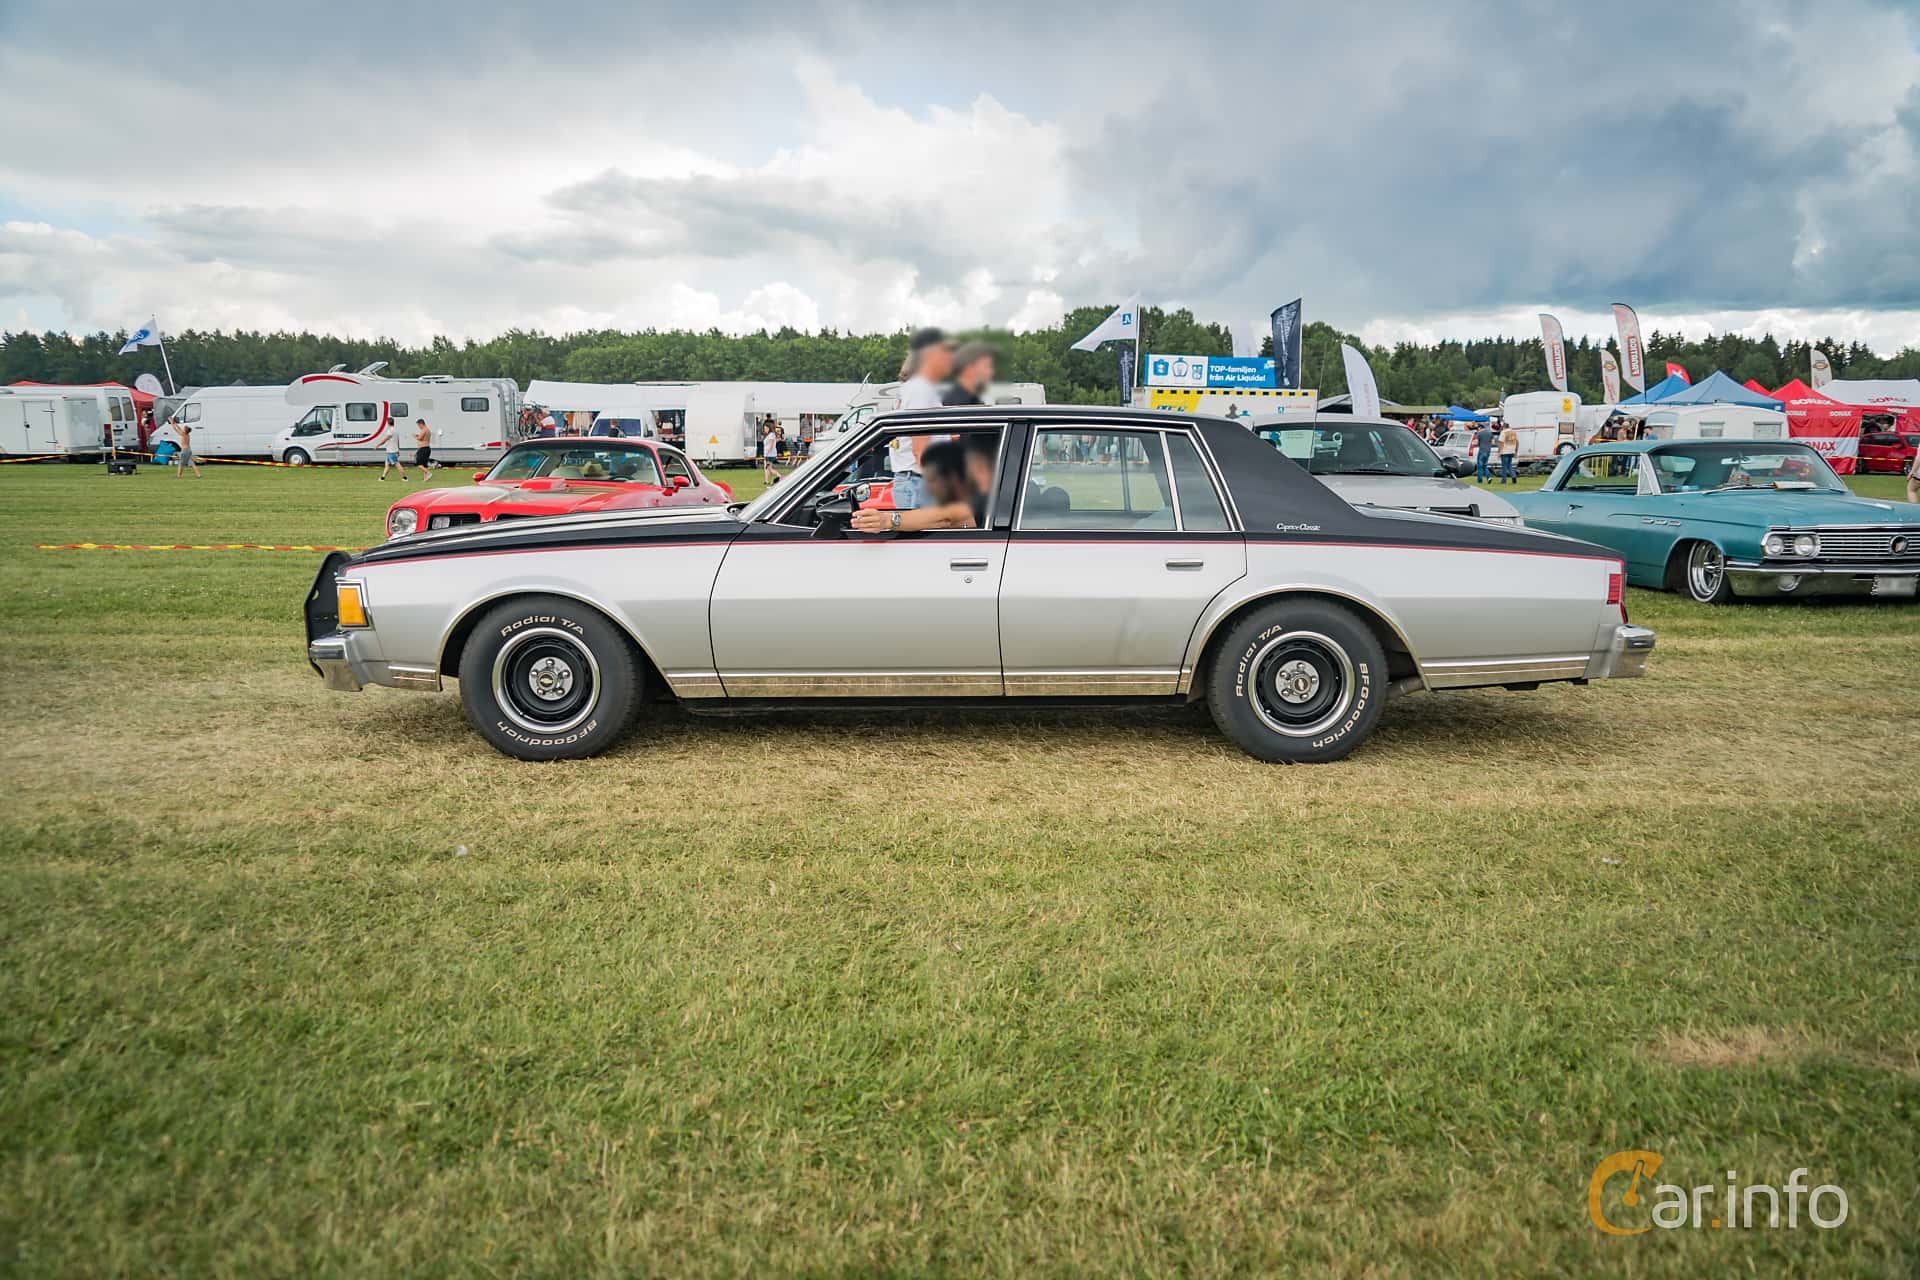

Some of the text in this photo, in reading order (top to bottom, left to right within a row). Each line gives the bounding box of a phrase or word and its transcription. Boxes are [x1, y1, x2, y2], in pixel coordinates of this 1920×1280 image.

[1210, 365, 1256, 374] TOP-familjen
[501, 615, 584, 637] Radial T/A
[1236, 624, 1282, 696] T/A Radial
[1312, 663, 1370, 748] BFGoodrich
[497, 720, 597, 746] BFGoodrich
